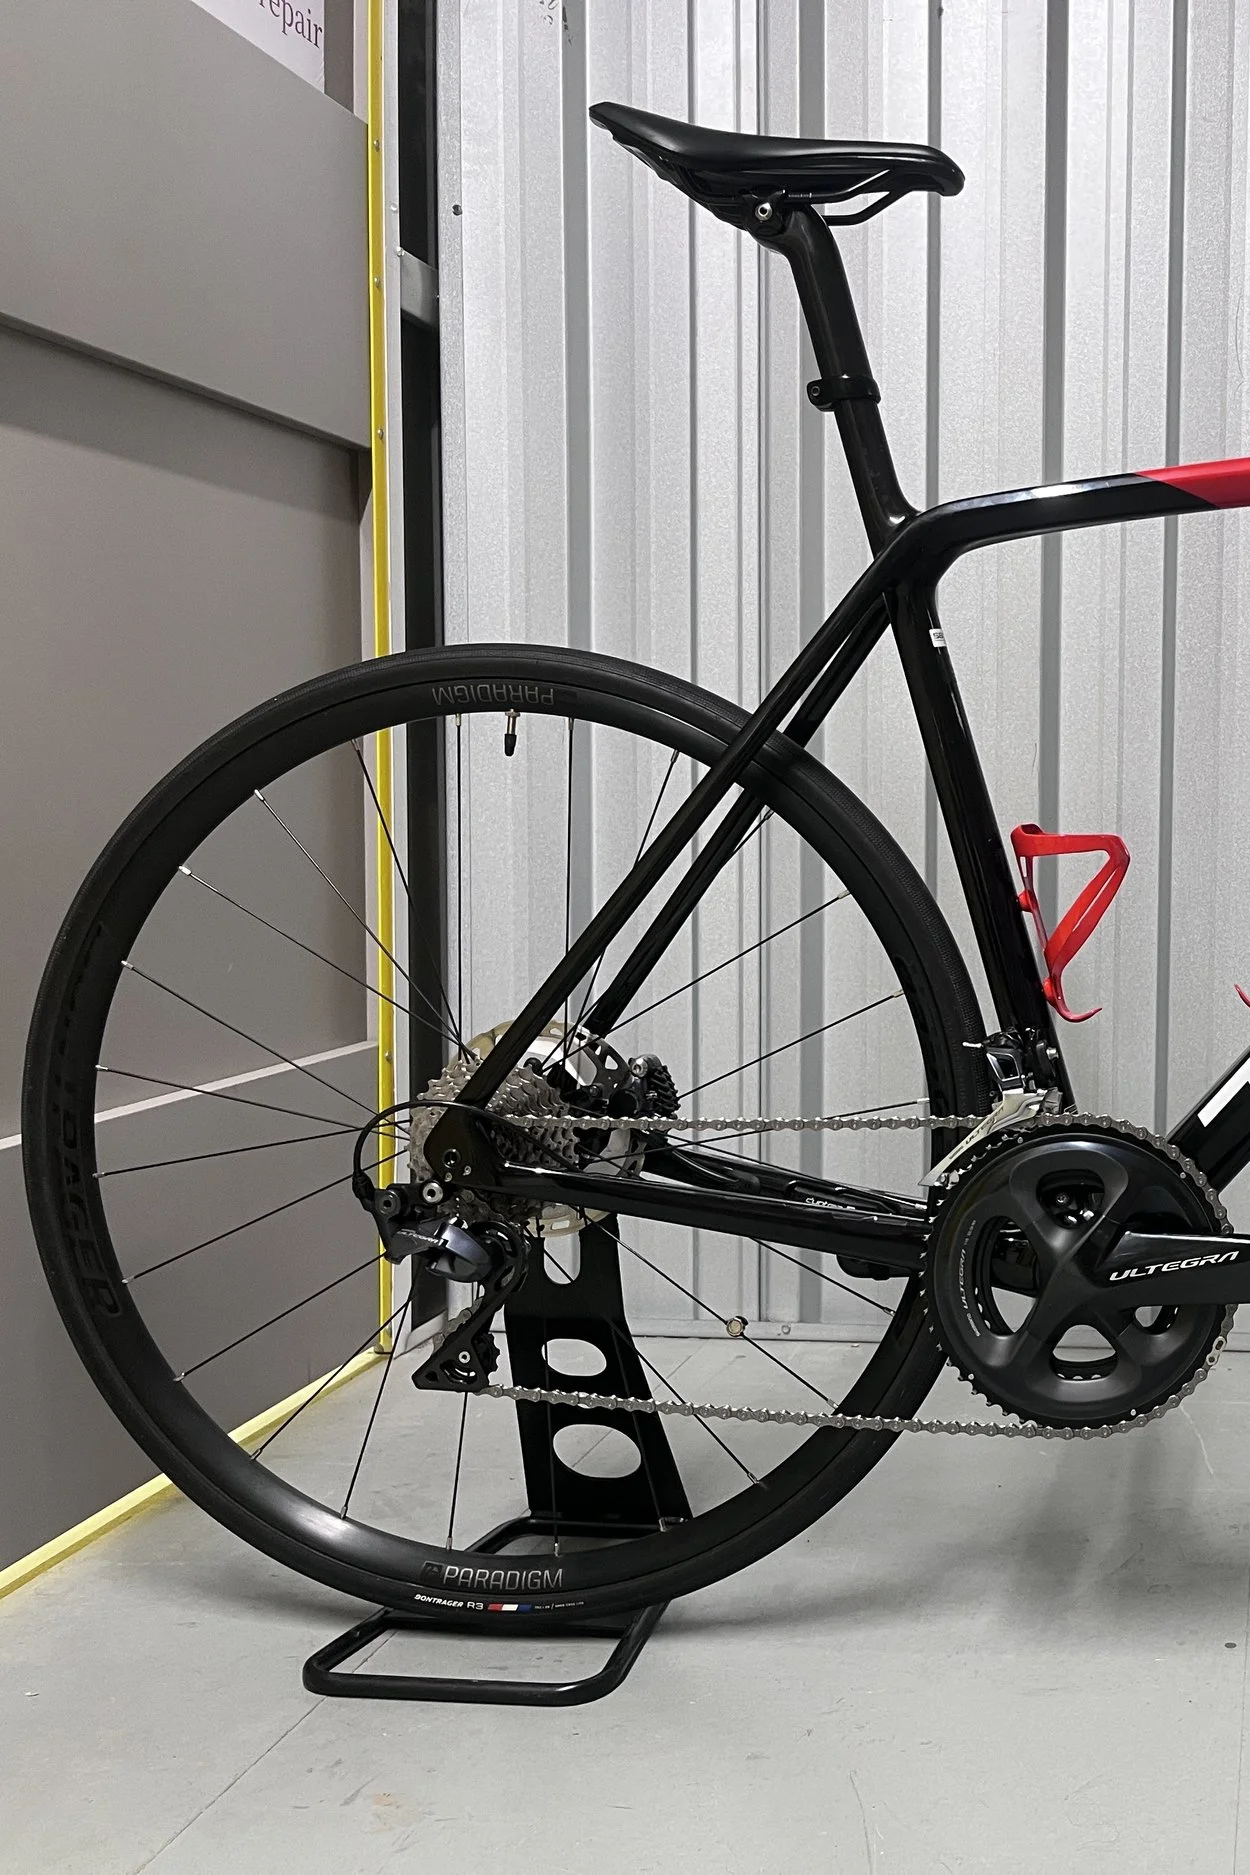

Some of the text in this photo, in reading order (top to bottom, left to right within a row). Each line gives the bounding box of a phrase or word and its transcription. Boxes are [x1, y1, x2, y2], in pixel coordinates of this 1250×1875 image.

[432, 684, 555, 707] PARADIGM
[1110, 1250, 1240, 1281] ULTEGRA
[958, 1248, 969, 1310] ULTEGRA
[443, 1565, 564, 1591] PARADIGM
[414, 1593, 484, 1611] BONTRAGER R3
